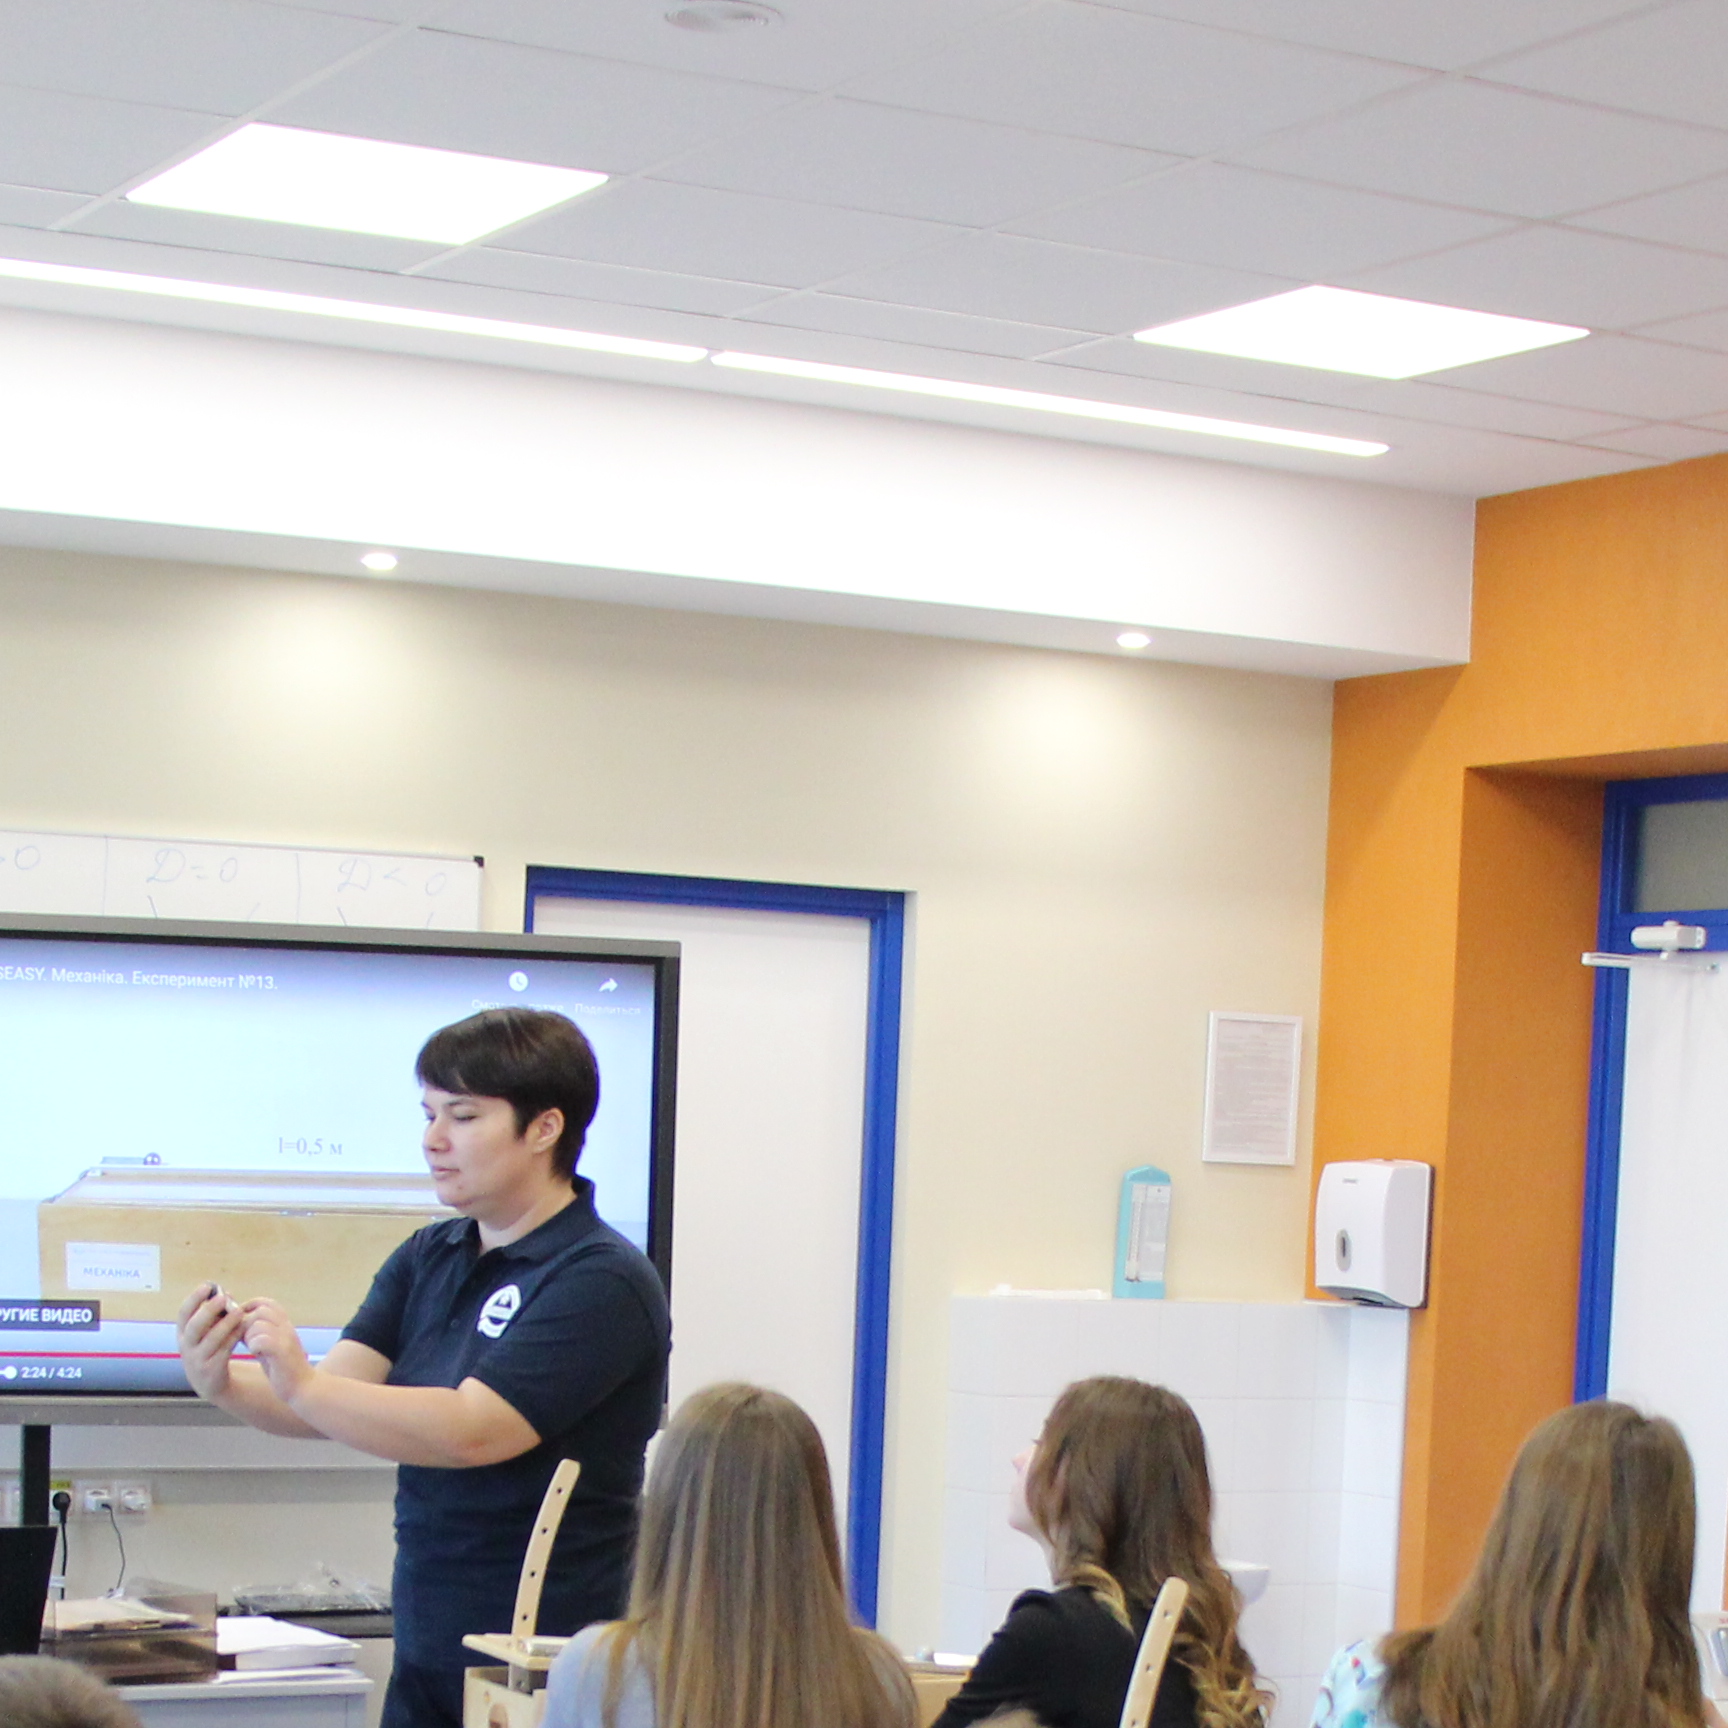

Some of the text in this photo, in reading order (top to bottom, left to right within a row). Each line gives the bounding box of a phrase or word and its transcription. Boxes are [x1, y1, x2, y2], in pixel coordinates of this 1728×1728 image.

[52, 968, 129, 985] Механіка.
[133, 971, 235, 990] Експеримент
[238, 975, 279, 990] №13.
[575, 1003, 641, 1016] Поделиться
[329, 1143, 343, 1155] м
[83, 1266, 141, 1279] МЕХАНІКА
[41, 1308, 93, 1324] ВИДЕО
[22, 1366, 47, 1379] 2:24
[56, 1367, 82, 1380] 4:24
